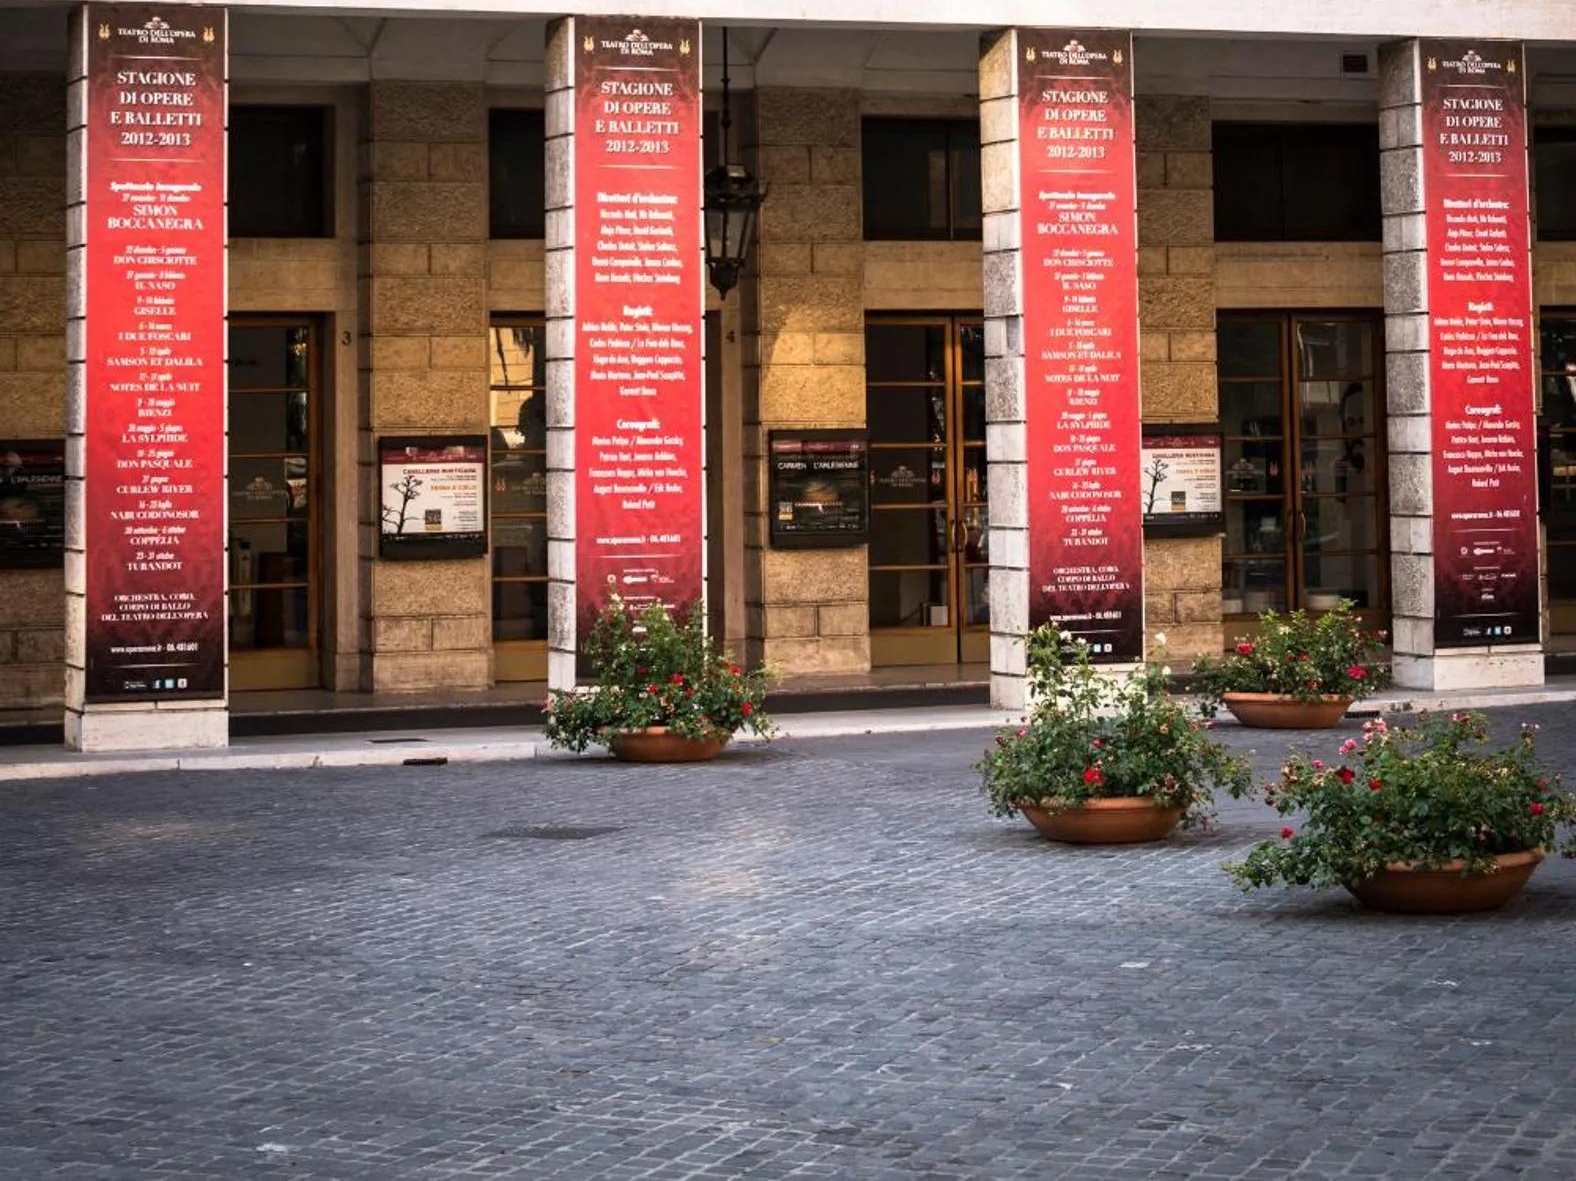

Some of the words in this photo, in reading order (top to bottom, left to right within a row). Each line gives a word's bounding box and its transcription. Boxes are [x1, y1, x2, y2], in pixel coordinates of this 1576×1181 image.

[119, 28, 148, 36] TEATRO
[601, 40, 629, 49] TEATRO
[117, 71, 196, 86] STAGIONE
[601, 81, 673, 96] STAGIONE
[121, 92, 137, 105] DI
[141, 92, 193, 105] OPERE
[1042, 90, 1108, 104] STAGIONE
[604, 102, 620, 115] DI
[623, 102, 671, 115] OPERE
[1443, 98, 1503, 111] STAGIONE
[110, 112, 120, 124] E
[125, 112, 202, 126] BALLETTI
[1044, 110, 1059, 122] DI
[1062, 110, 1107, 122] OPERE
[1446, 117, 1459, 128] DI
[1462, 117, 1502, 128] OPERE
[596, 121, 606, 133] E
[609, 121, 679, 135] BALLETTI
[1037, 128, 1048, 139] E
[1050, 128, 1114, 140] BALLETTI
[121, 132, 190, 146] 2012-2013
[1439, 134, 1449, 144] E
[1451, 134, 1509, 146] BALLETTI
[606, 140, 669, 153] 2012-2013
[1047, 145, 1105, 159] 2012-2013
[1448, 151, 1502, 163] 2012-2013
[133, 205, 178, 216] SIMON
[1058, 211, 1096, 222] SIMON
[107, 217, 204, 230] BOCCANEGRA
[1038, 223, 1118, 235] BOCCANEGRA
[134, 307, 176, 315] GISELLE
[341, 331, 352, 346] 3
[126, 562, 183, 571] TURANDOT
